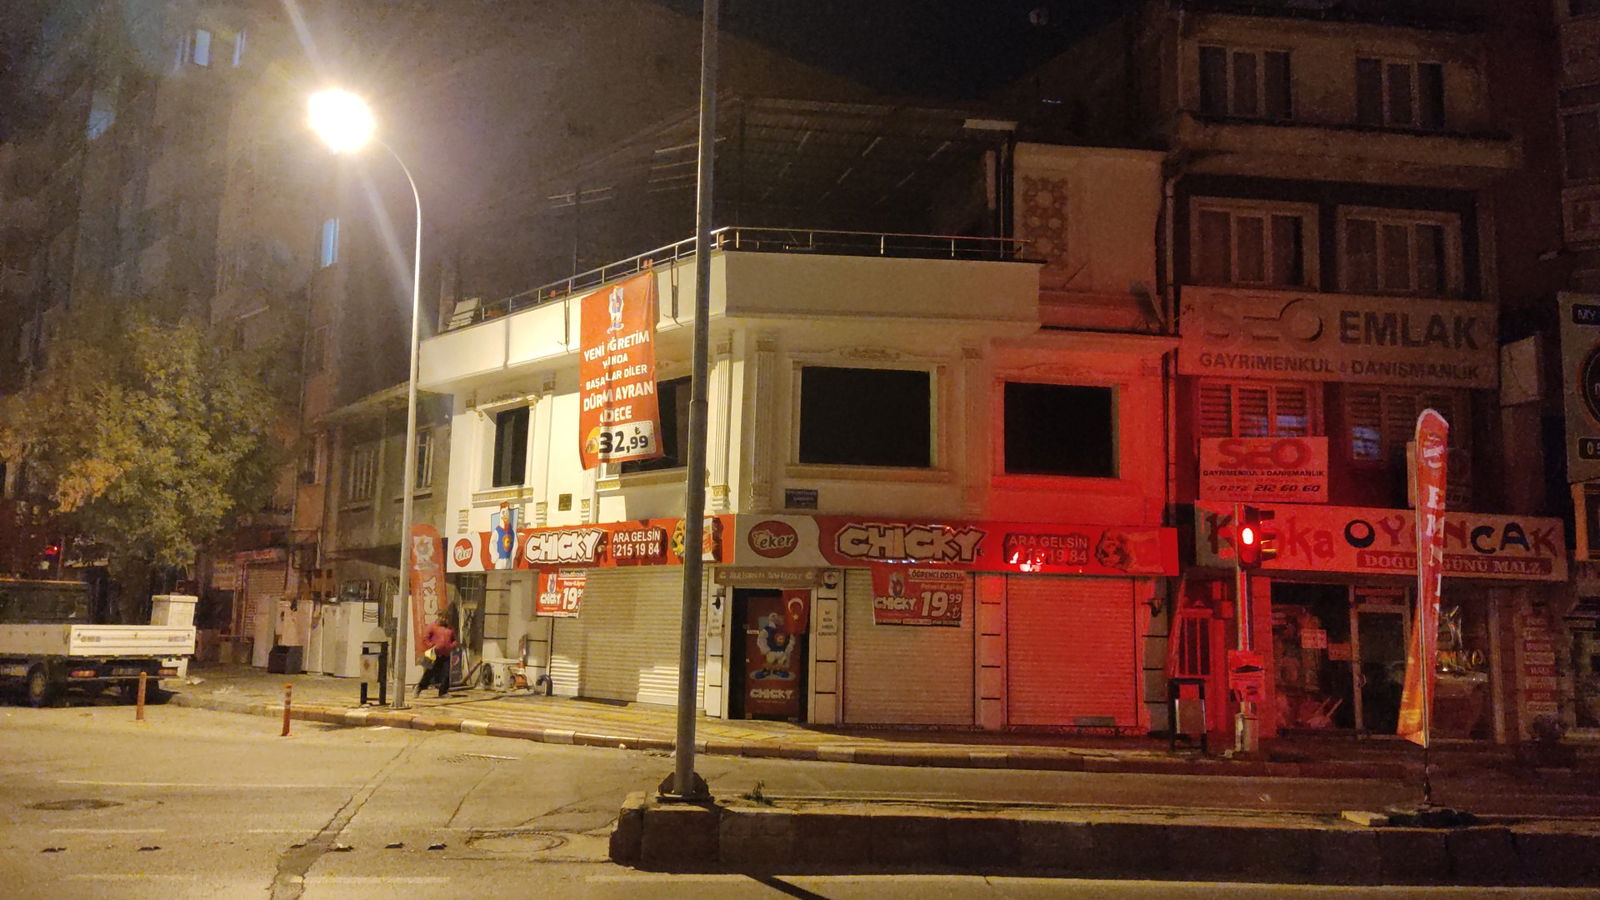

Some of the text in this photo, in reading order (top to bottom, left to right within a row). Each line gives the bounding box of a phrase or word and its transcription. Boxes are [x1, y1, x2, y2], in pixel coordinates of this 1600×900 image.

[1339, 310, 1479, 350] EMLAK
[583, 341, 605, 362] YENİ
[623, 364, 648, 378] DİLER
[615, 380, 654, 401] AYRAN
[598, 430, 649, 454] 32,99
[1218, 438, 1312, 469] SEO
[1254, 484, 1277, 492] 212
[1280, 484, 1298, 492] 60
[1302, 484, 1321, 492] 60
[612, 528, 661, 543] ARA GELSİN
[836, 523, 984, 563] CHICKY
[1008, 535, 1088, 549] ARA GELSİN
[1344, 516, 1558, 557] OYNCAK
[525, 528, 602, 564] CHICKY
[616, 543, 633, 556] 215
[635, 543, 646, 556] 19
[648, 542, 660, 555] 84
[1050, 549, 1065, 562] 19
[1069, 549, 1088, 562] 84
[1364, 551, 1417, 569] DOĞU
[874, 596, 917, 611] CHICKY
[750, 688, 793, 700] CHICKY
